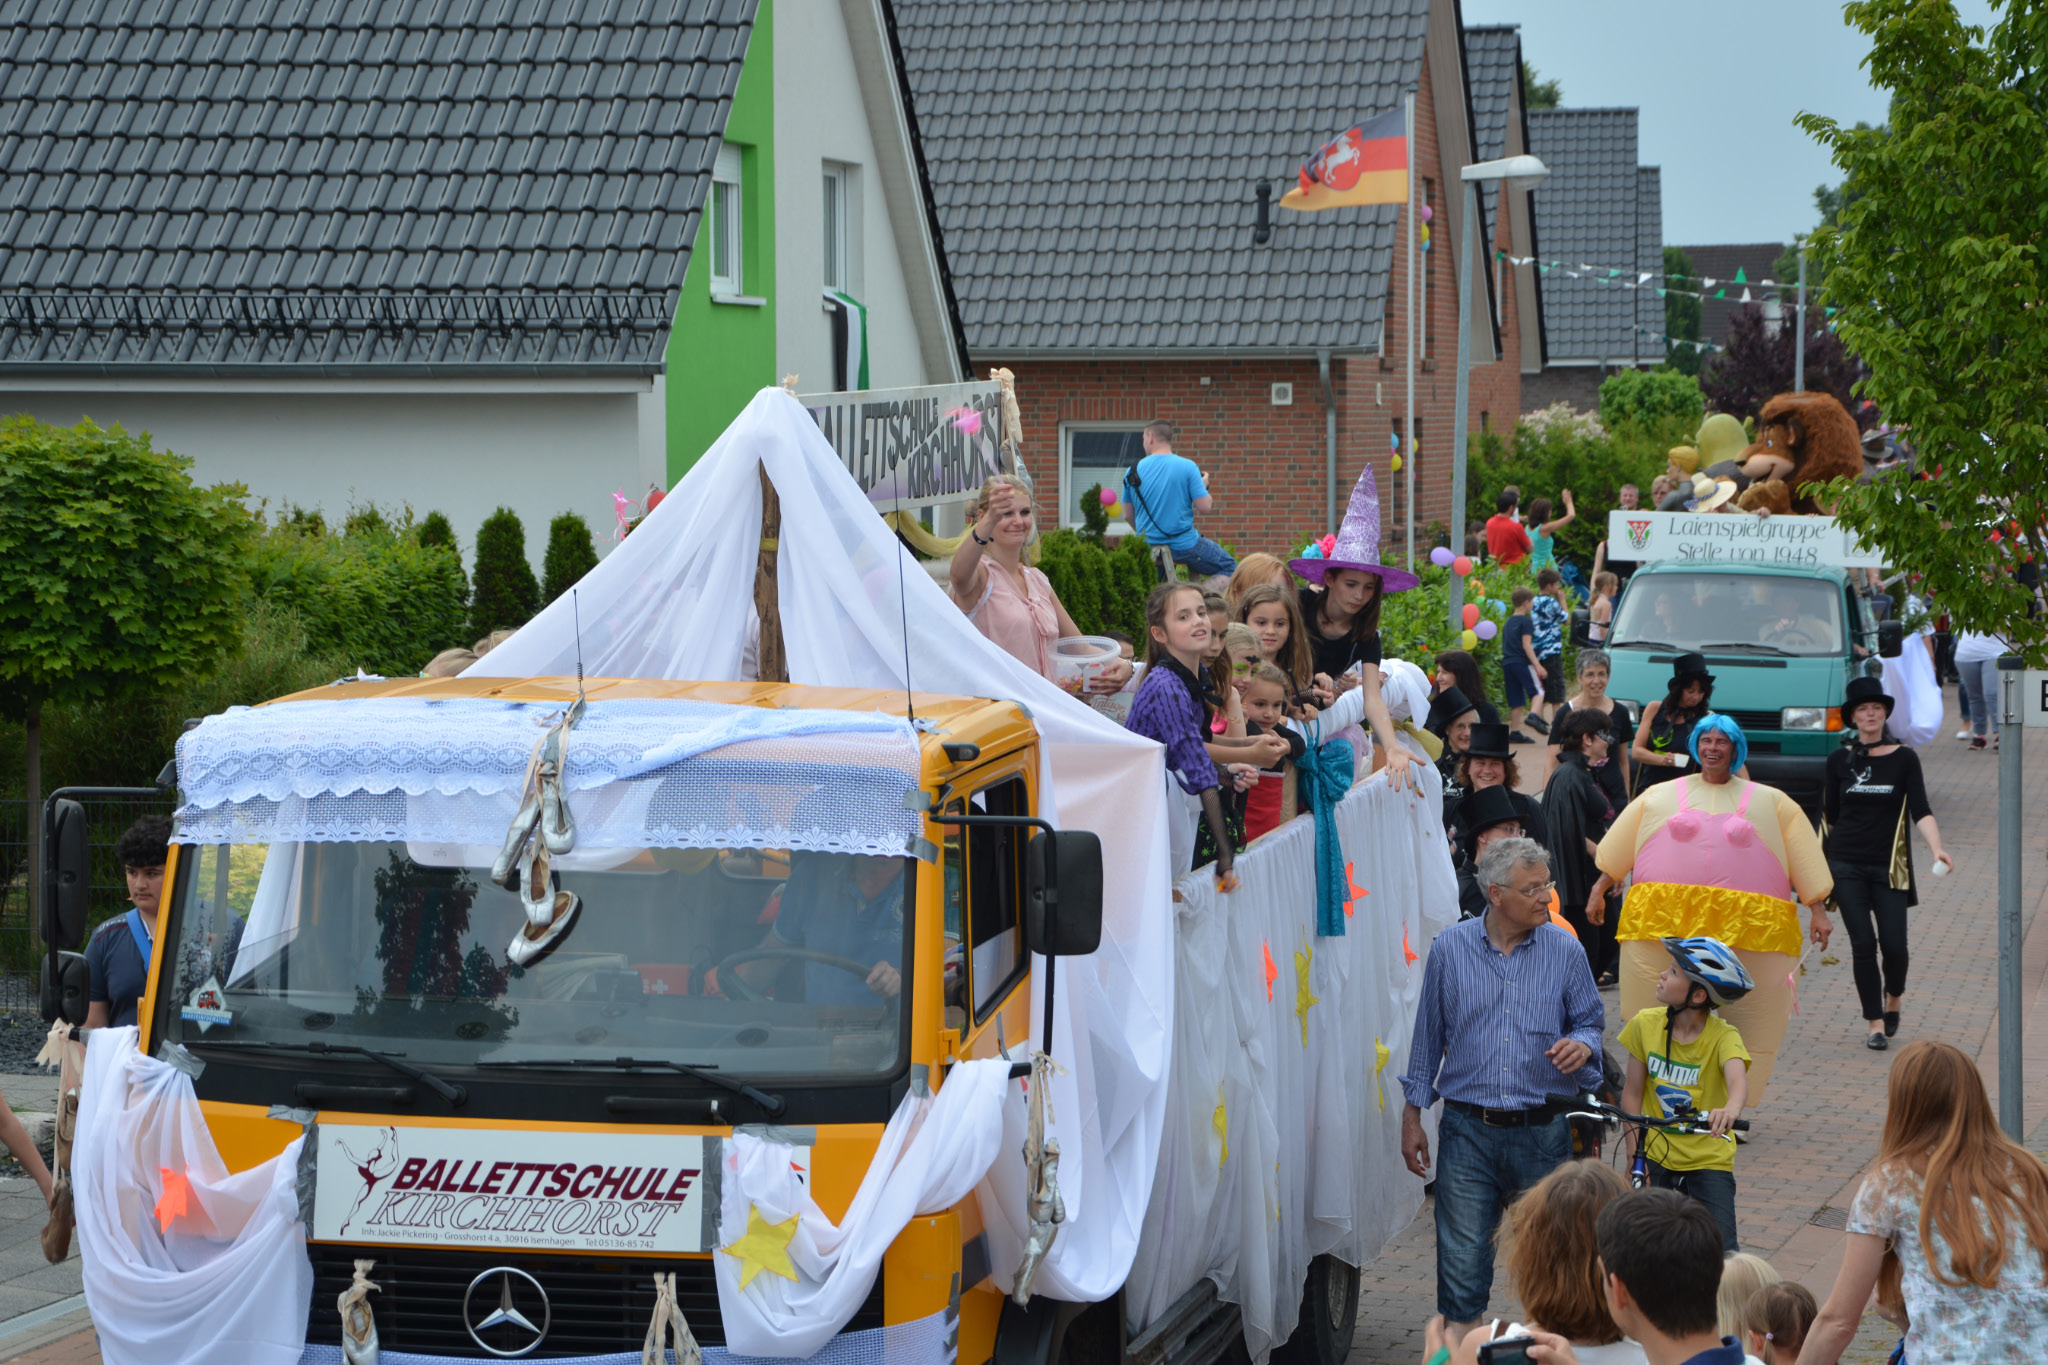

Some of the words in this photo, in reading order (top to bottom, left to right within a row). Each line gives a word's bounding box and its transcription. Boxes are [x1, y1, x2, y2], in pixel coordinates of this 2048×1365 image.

[1669, 517, 1827, 543] Laienspielgruppe
[1677, 543, 1722, 560] Stelle
[1775, 546, 1818, 563] 1948
[1648, 1056, 1700, 1086] PUMA
[391, 1157, 701, 1201] BALLETTSCHULE
[366, 1191, 681, 1236] KIRCHHORST
[377, 1229, 401, 1238] Jackie
[402, 1230, 438, 1241] Pickering
[444, 1232, 486, 1241] Grosshorst
[504, 1235, 529, 1243] 30916
[530, 1236, 576, 1246] Isernhagen
